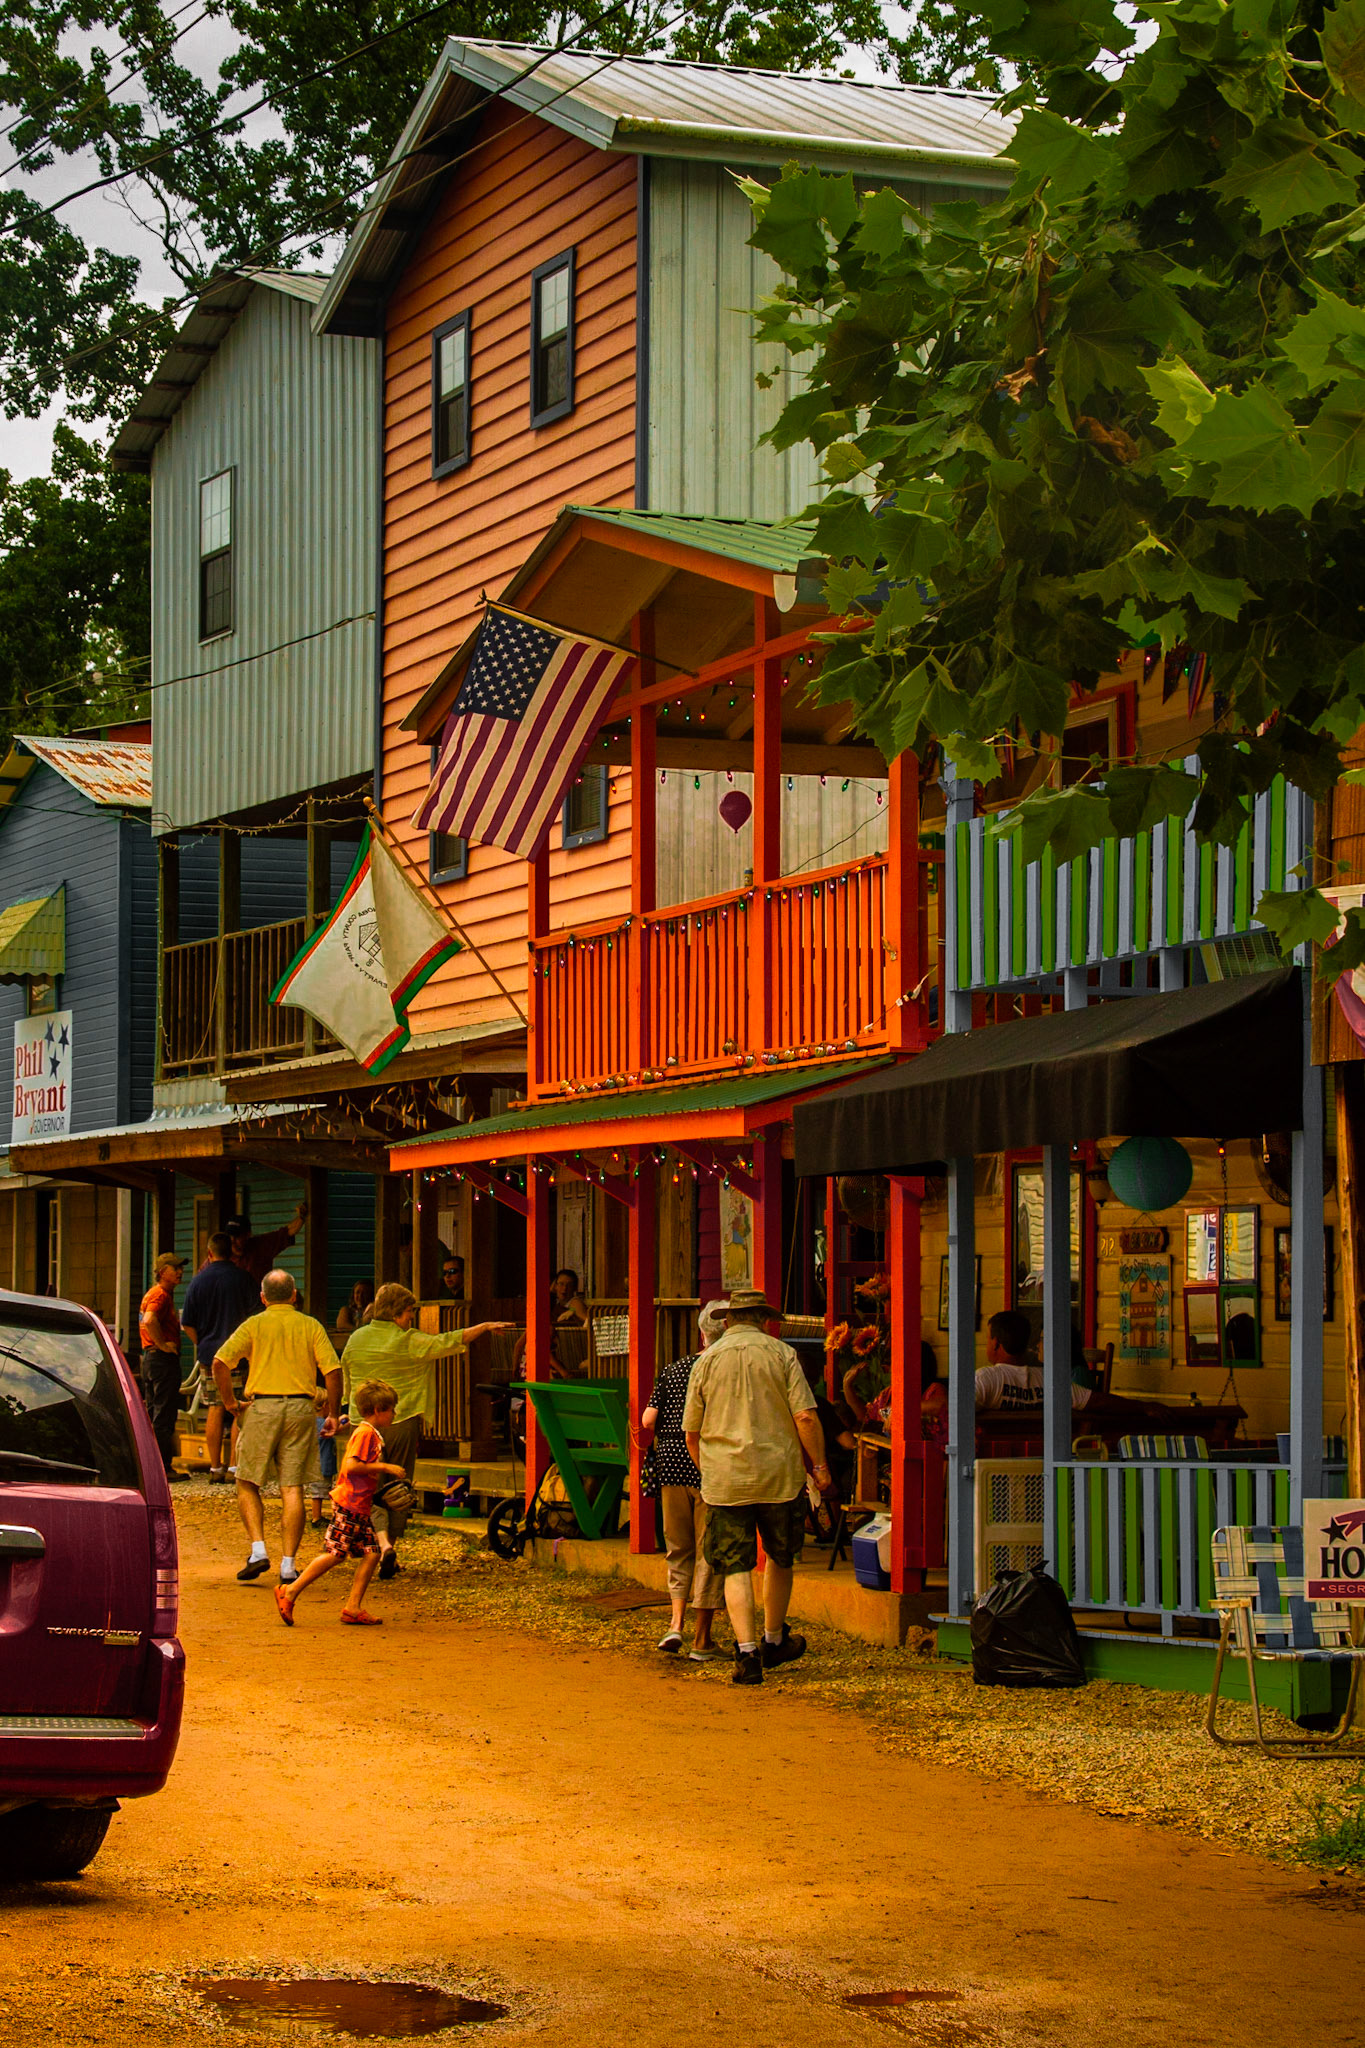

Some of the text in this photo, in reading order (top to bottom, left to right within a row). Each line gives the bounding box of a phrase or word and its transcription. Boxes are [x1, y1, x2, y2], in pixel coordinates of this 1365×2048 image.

[15, 1038, 44, 1080] Phil
[14, 1079, 67, 1135] Bryant
[33, 1116, 65, 1134] GOVERNOR
